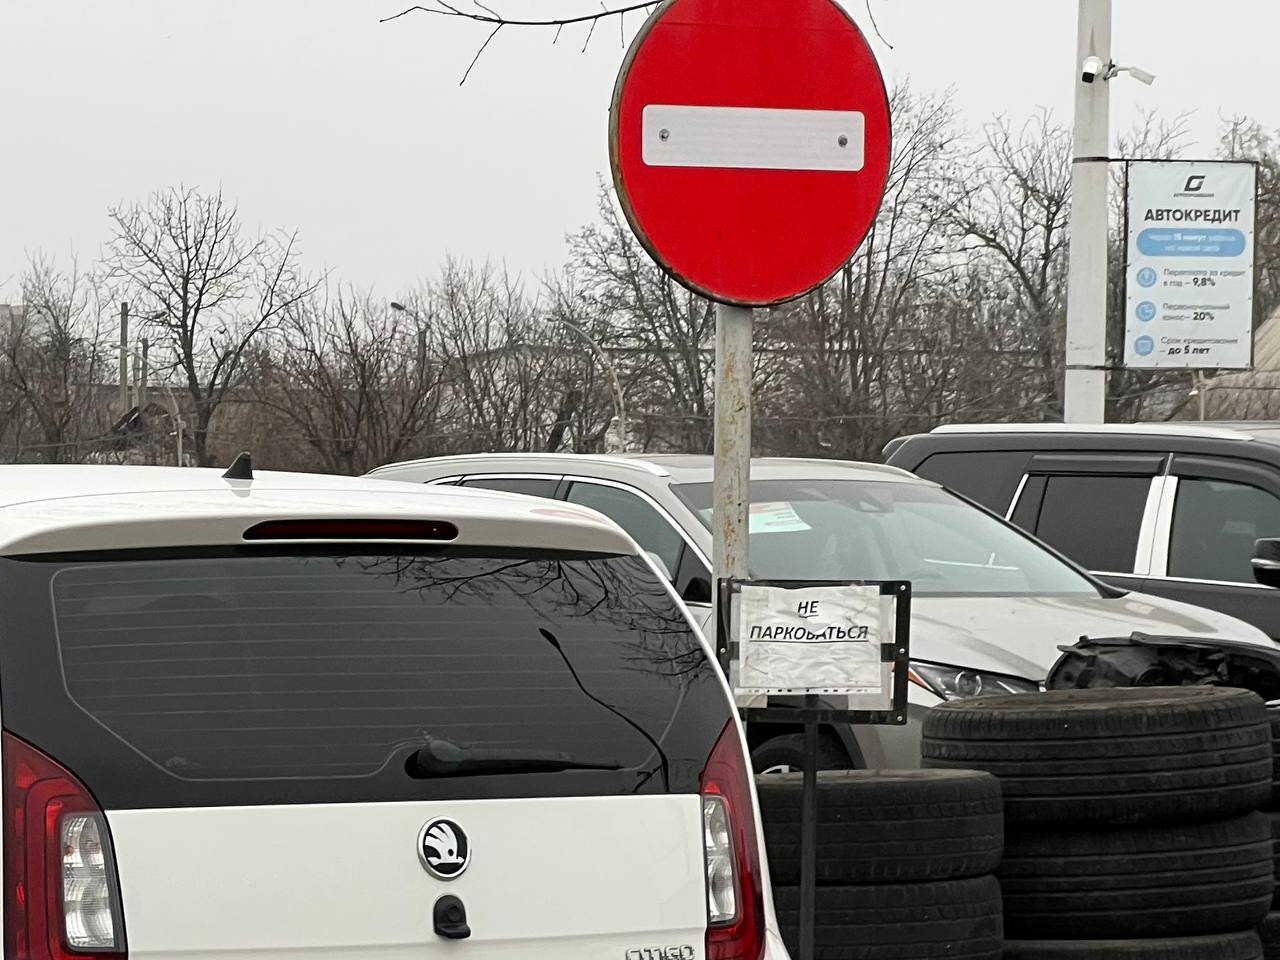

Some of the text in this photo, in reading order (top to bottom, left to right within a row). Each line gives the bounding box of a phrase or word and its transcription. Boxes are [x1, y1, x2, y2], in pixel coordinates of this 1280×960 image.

[1144, 208, 1241, 224] АВТОКРЕДИТ
[1192, 277, 1216, 288] 9,8%
[1193, 311, 1215, 321] 20%
[1168, 346, 1181, 355] до
[1184, 345, 1190, 355] 5
[1192, 347, 1211, 355] лет
[797, 600, 820, 614] НЕ
